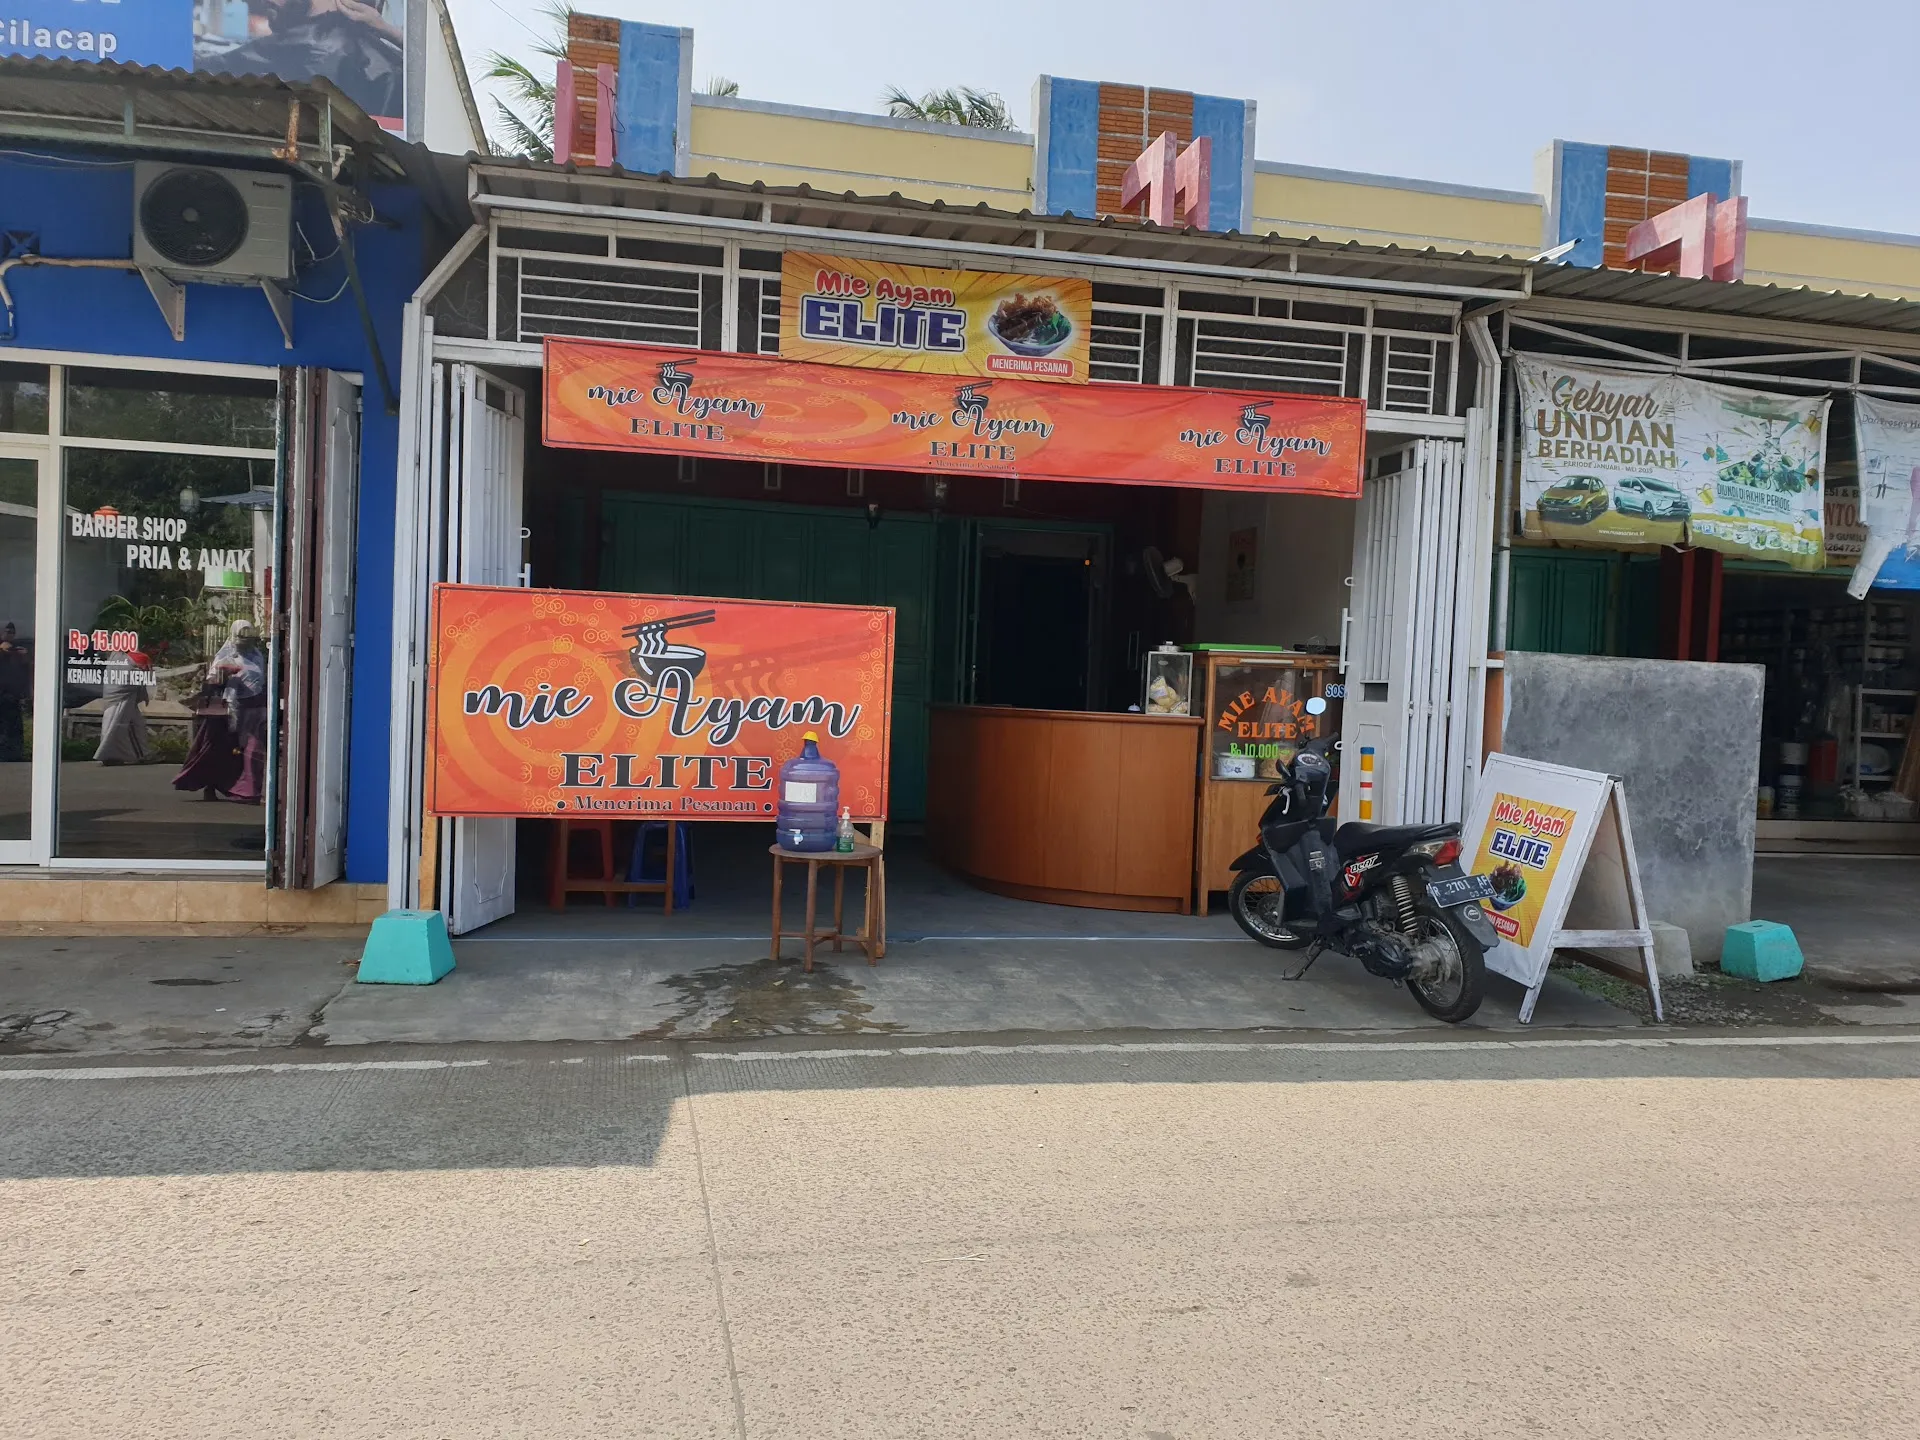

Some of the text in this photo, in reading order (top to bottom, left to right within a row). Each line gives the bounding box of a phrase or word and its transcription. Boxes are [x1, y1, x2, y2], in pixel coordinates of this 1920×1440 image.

[0, 19, 117, 59] ilacap
[816, 269, 955, 308] Mie Ayam
[801, 295, 966, 352] ELITE
[991, 358, 1069, 374] MENERIMA PESANAN
[588, 382, 765, 420] mie Ayam
[1551, 375, 1659, 423] Gebyar
[629, 417, 724, 441] ELITE
[892, 404, 1054, 441] mie Ayam
[1537, 409, 1675, 449] UNDIAN
[929, 440, 1016, 461] ELITE
[1179, 423, 1332, 458] mie Ayam
[1538, 438, 1676, 468] BERHADIAH
[1214, 457, 1297, 477] ELITE
[1563, 460, 1592, 469] PERIODE
[1593, 462, 1621, 472] JANUARI
[71, 513, 187, 542] BARBER SHOP
[126, 545, 252, 573] PRIA & ANAK
[69, 628, 139, 655] Rp 15.000
[67, 668, 157, 686] KERAMAS & PIJIT KEPALA
[463, 665, 862, 747] mie Ayam
[1218, 686, 1315, 734] MIE AYAM
[1237, 721, 1297, 739] ELITE
[559, 752, 774, 791] ELITE
[573, 795, 757, 812] Menerima Pesanan
[1495, 801, 1566, 837] Mie Ayam
[1489, 828, 1552, 869] ELITE
[1432, 875, 1489, 898] R 2701 AF
